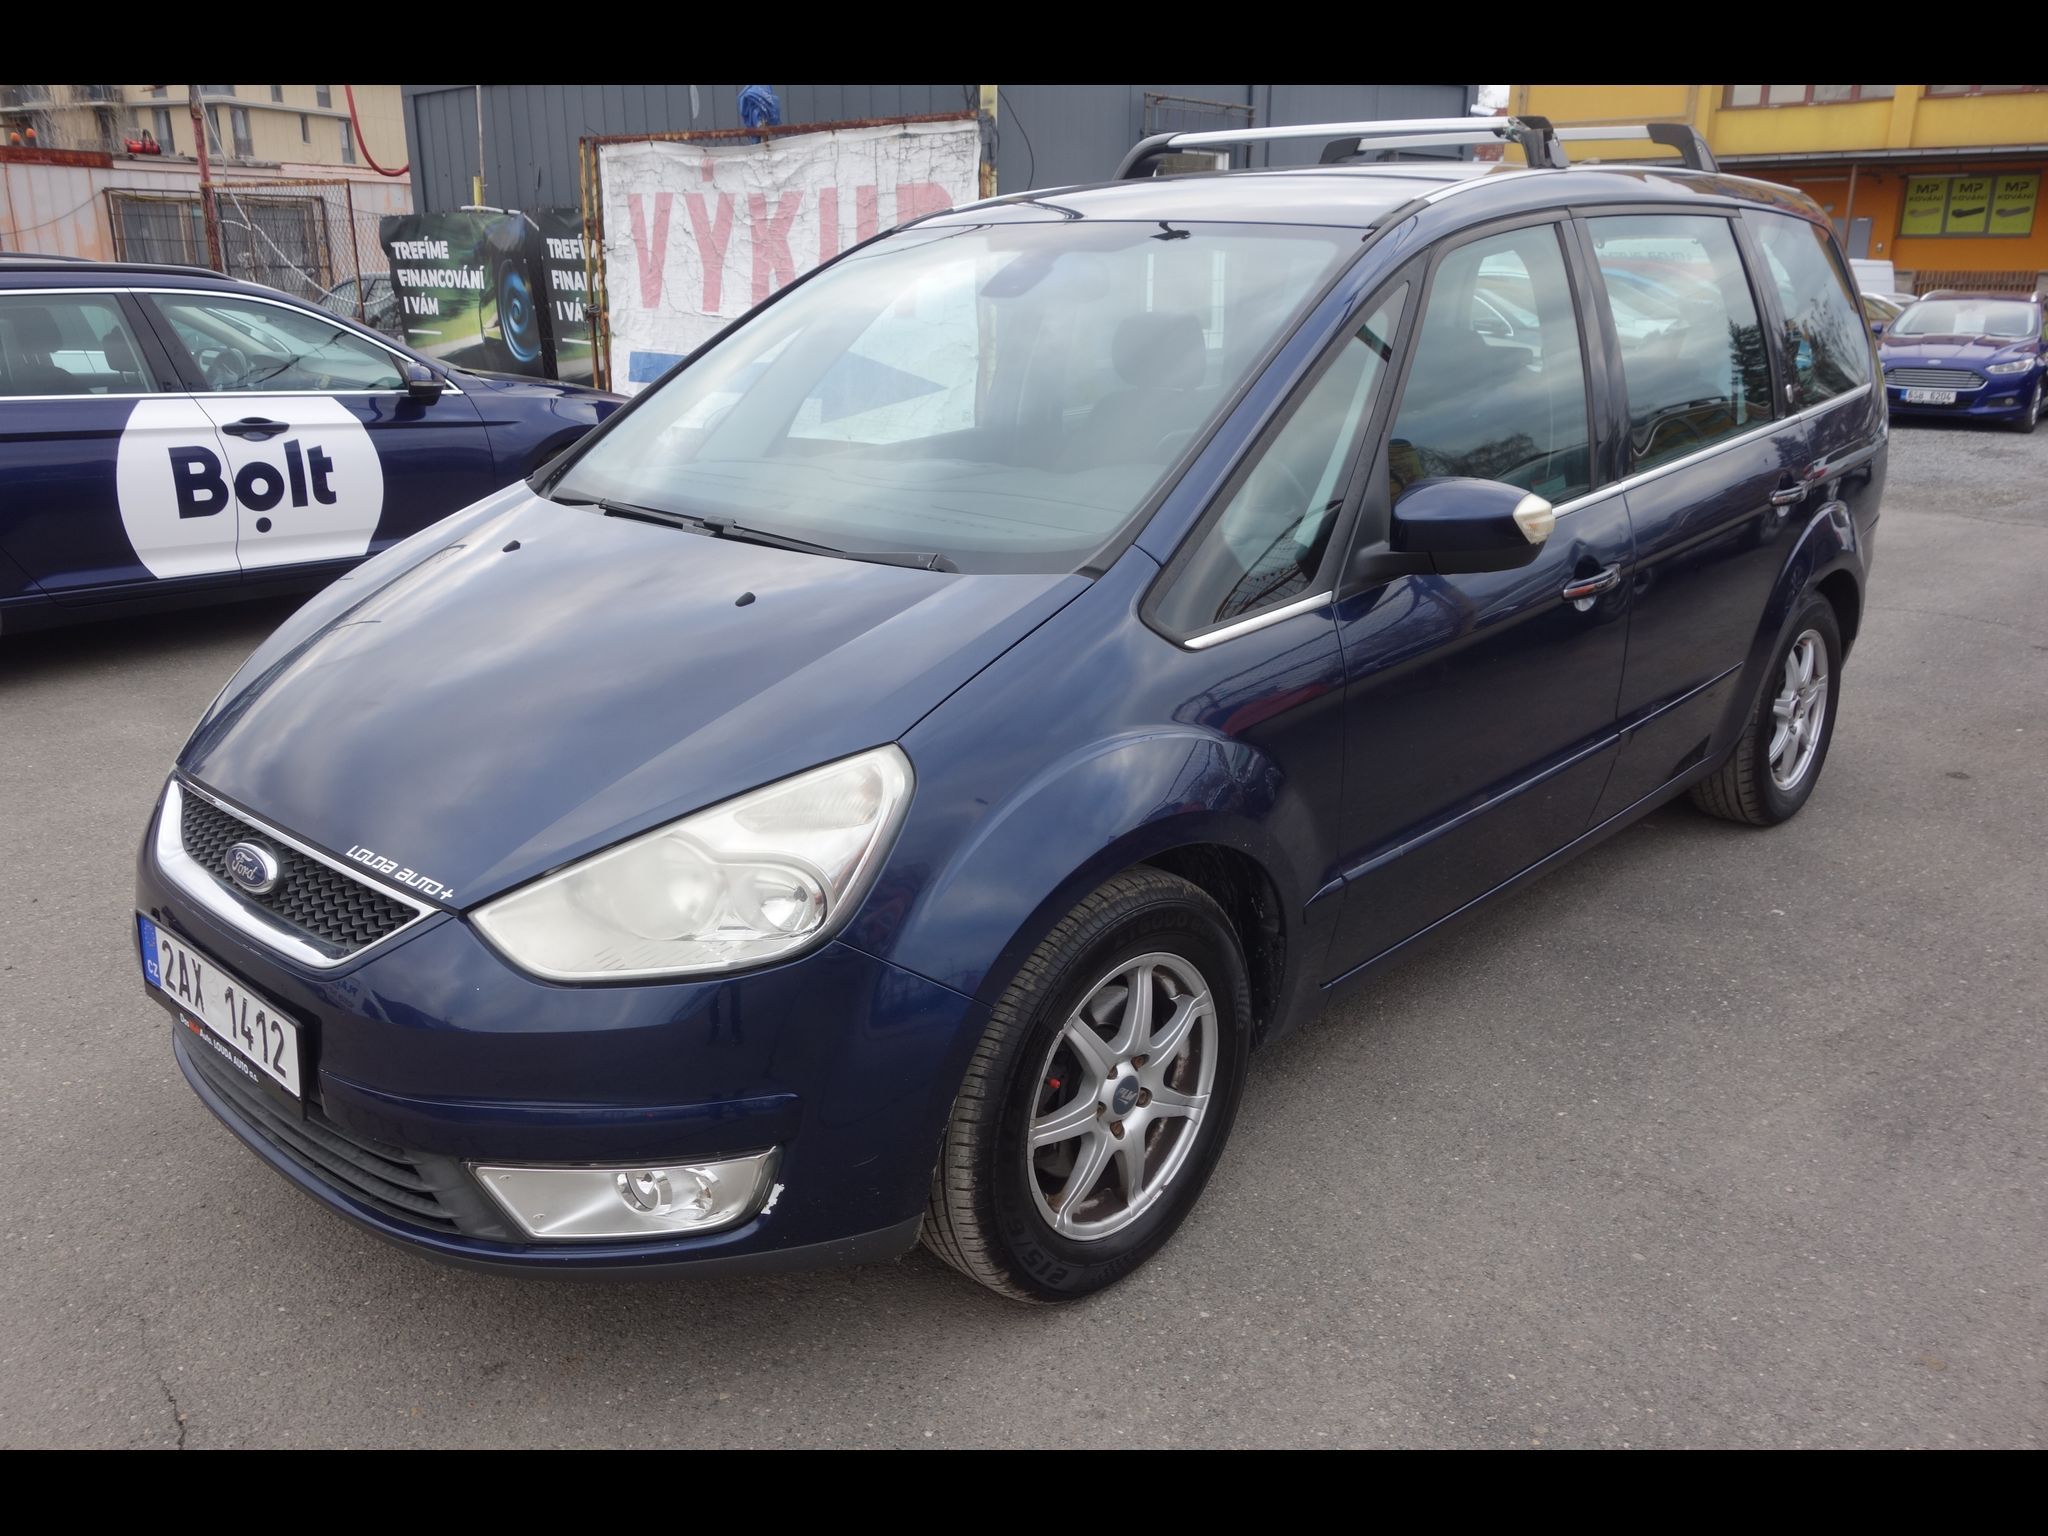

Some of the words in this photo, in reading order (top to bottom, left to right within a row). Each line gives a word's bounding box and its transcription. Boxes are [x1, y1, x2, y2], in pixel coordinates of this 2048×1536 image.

[1916, 183, 1940, 195] MP
[1959, 183, 1984, 194] MP
[2004, 181, 2030, 193] MP
[390, 236, 450, 260] TREFÍME
[397, 265, 485, 290] FINANCOVÁNÍ
[403, 296, 411, 314] I
[411, 292, 440, 316] VÁM
[556, 300, 563, 320] I
[563, 297, 588, 321] VÁ
[168, 438, 338, 534] Bolt
[231, 851, 259, 881] Ford
[147, 959, 160, 978] CZ
[161, 939, 206, 1016] 2AX
[224, 985, 287, 1079] 1412
[213, 1039, 233, 1062] LOUDA
[233, 1055, 249, 1075] AUTO
